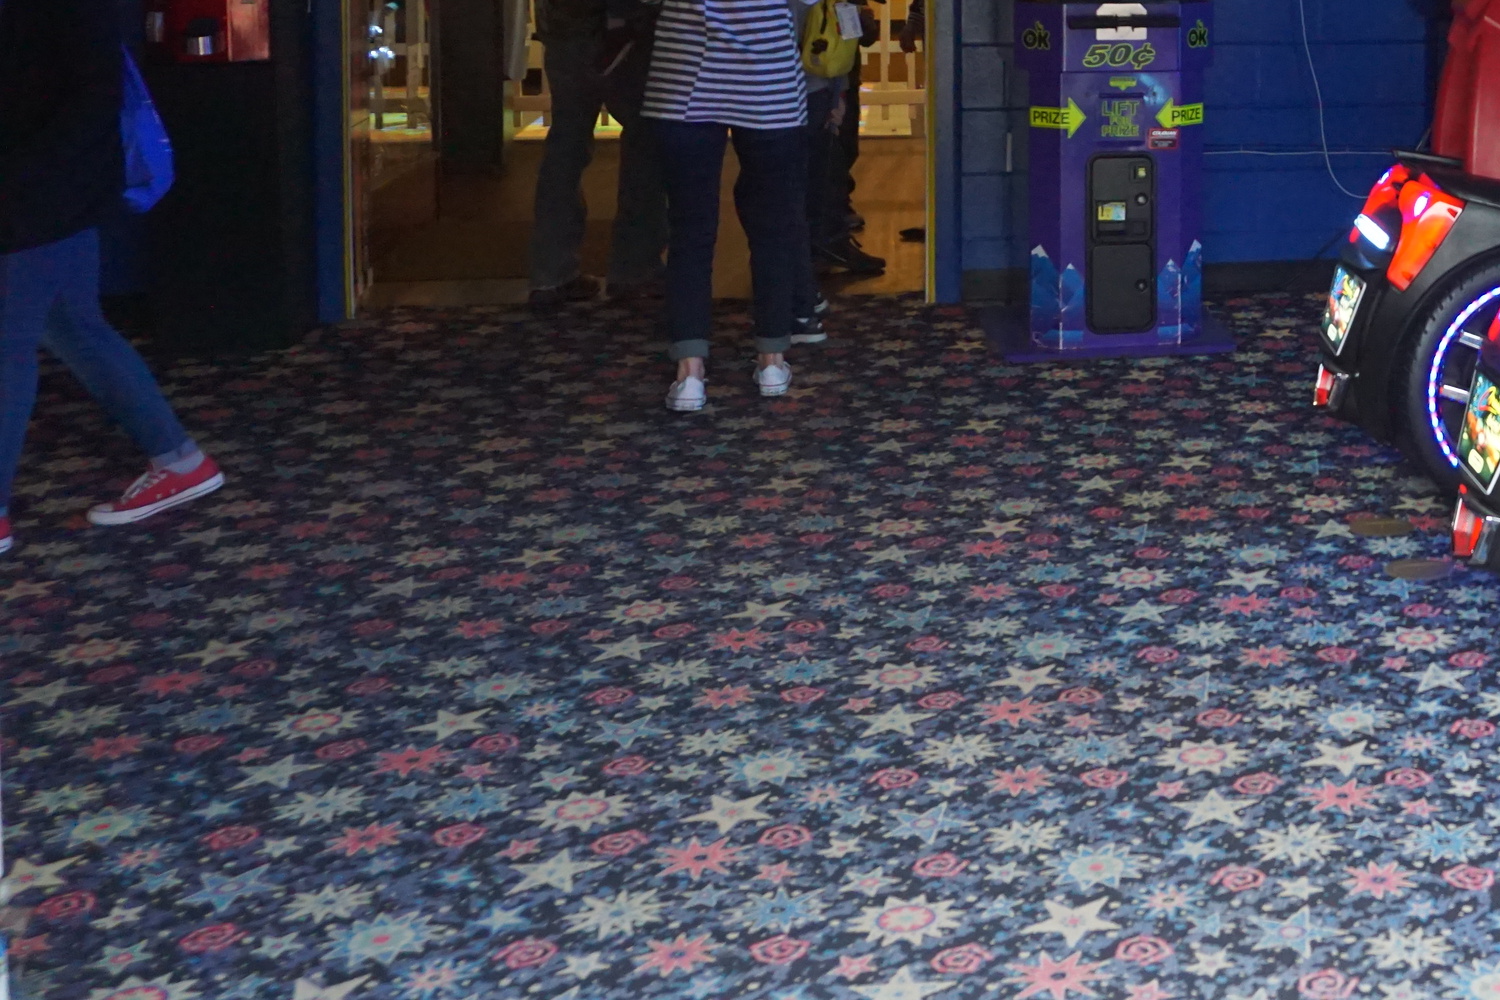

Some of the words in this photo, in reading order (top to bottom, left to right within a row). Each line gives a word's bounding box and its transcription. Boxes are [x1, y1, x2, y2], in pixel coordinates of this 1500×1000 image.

[1082, 42, 1156, 71] 50¢
[1101, 100, 1140, 117] LIFT
[1171, 107, 1202, 123] PRIZE
[1032, 110, 1070, 126] PRIZE
[1101, 124, 1140, 138] PRIZE
